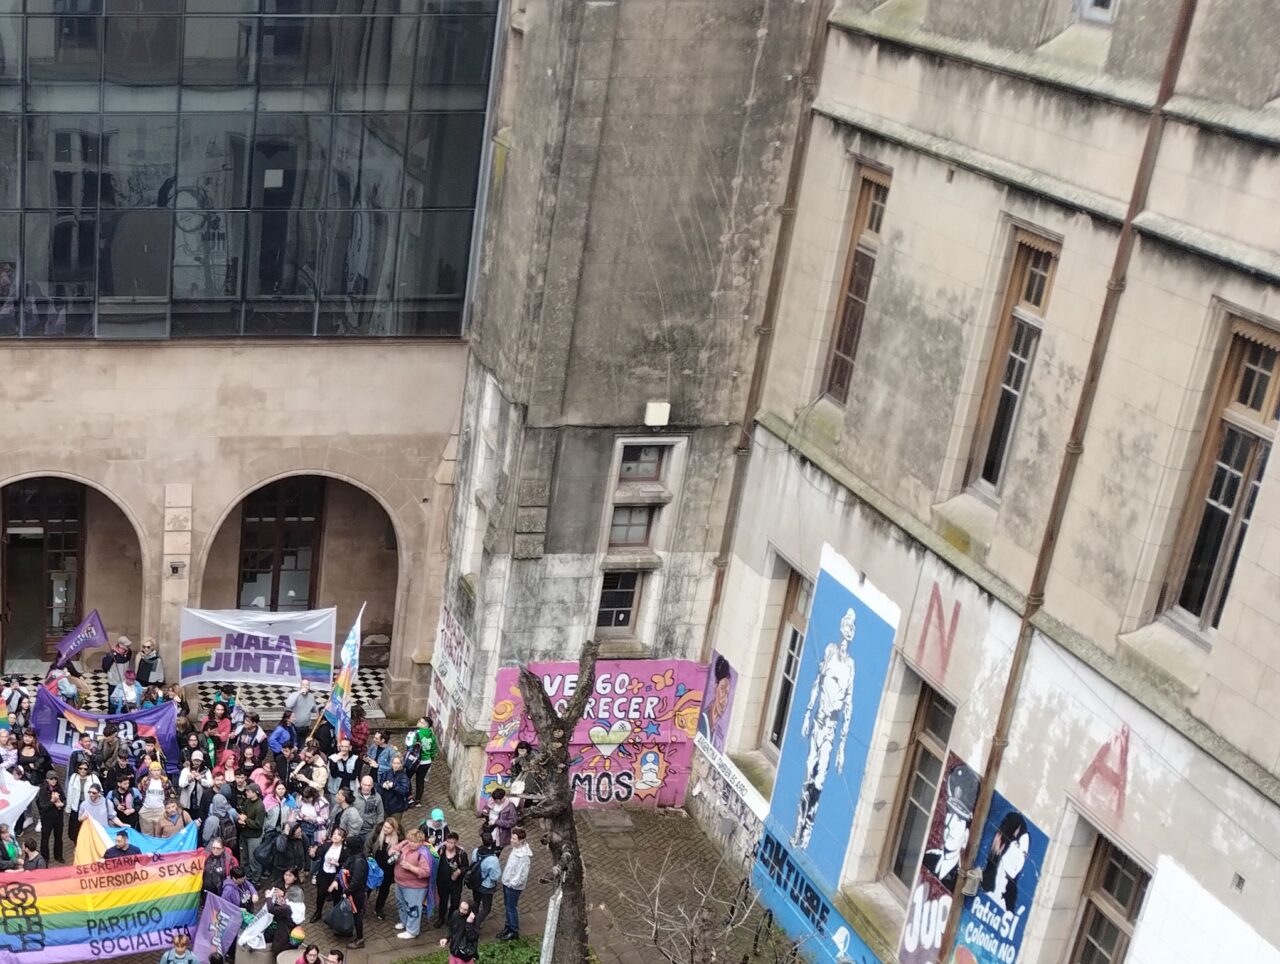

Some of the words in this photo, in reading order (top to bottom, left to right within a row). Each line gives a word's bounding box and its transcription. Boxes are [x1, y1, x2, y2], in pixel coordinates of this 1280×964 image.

[225, 633, 293, 654] MALA
[207, 651, 297, 676] JUNTA
[544, 673, 631, 697] VEGO
[554, 698, 660, 720] ORECER
[572, 771, 634, 804] MOS
[80, 870, 150, 891] DIVERSIDAD
[86, 906, 163, 936] PARTIDO
[972, 896, 1001, 932] Patria
[90, 924, 192, 957] SOCIALISTA
[965, 922, 999, 952] Colonia
